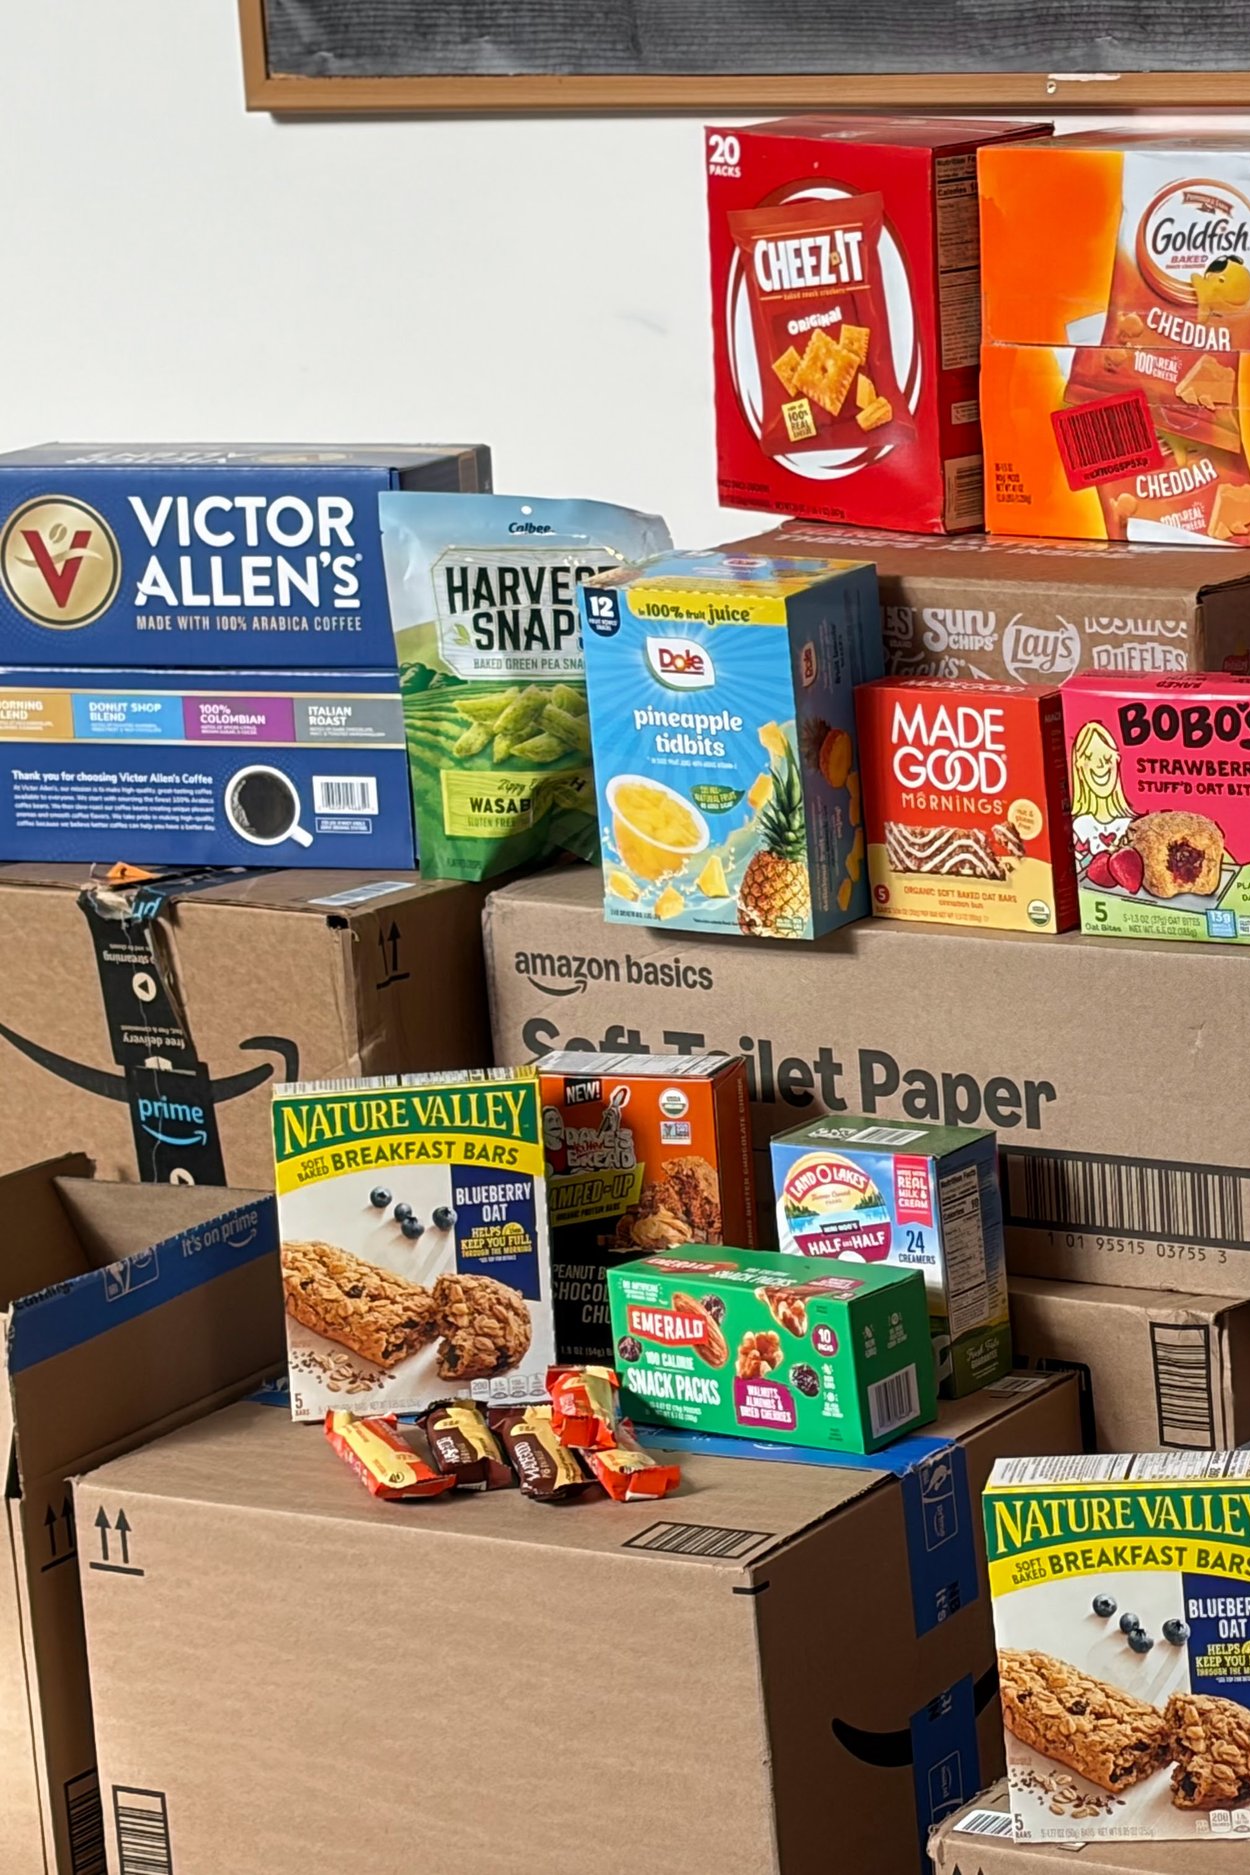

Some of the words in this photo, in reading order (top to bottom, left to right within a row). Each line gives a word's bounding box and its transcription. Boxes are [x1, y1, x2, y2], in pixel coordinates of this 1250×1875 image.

[709, 135, 741, 165] 20
[709, 165, 741, 178] PACKS
[1152, 216, 1250, 255] Goldfish
[788, 306, 842, 335] ORIGINAL
[1147, 307, 1231, 351] CHEDDAR
[1159, 357, 1178, 373] REAL
[1152, 367, 1178, 384] CHEESE
[1136, 458, 1218, 499] CHEDDAR
[127, 496, 356, 548] VICTOR
[508, 522, 552, 534] Calbee
[134, 551, 360, 609] ALLEN'S
[589, 596, 615, 617] 12
[645, 603, 684, 620] 100%
[707, 604, 747, 625] juice
[136, 616, 172, 631] MADE
[177, 616, 210, 631] WITH
[252, 616, 309, 632] ARABICA
[314, 617, 362, 632] COFFEE
[949, 635, 995, 650] CHIPS
[1011, 626, 1075, 673] Lay's
[474, 658, 502, 670] BAKED
[505, 658, 538, 670] GREEN
[541, 658, 560, 670] PEA
[658, 648, 704, 674] Dole
[200, 714, 265, 725] COLOMBIAN
[308, 706, 352, 717] ITALIAN
[309, 716, 346, 726] ROAST
[634, 708, 743, 735] pineapple
[892, 702, 1006, 752] MADE
[656, 733, 725, 757] tidbits
[11, 770, 41, 780] Thank
[43, 772, 59, 782] you
[61, 771, 74, 781] for
[77, 772, 117, 784] choosing
[119, 772, 147, 783] Victor
[182, 774, 213, 784] Coffee
[894, 746, 1007, 794] GOOD
[497, 778, 526, 795] Zippy
[1138, 780, 1193, 795] STUFF'D
[1196, 782, 1224, 795] OAT
[469, 797, 532, 814] WASAB
[904, 886, 936, 896] ORGANIC
[1095, 902, 1108, 922] 5
[515, 951, 620, 982] amazon
[625, 954, 714, 990] basics
[123, 1032, 163, 1048] delivery
[165, 1036, 185, 1049] free
[566, 1081, 600, 1104] NEW!
[858, 1048, 1057, 1130] Paper
[139, 1097, 203, 1126] prime
[281, 1098, 409, 1155] NATURE
[411, 1090, 527, 1137] VALLEY
[566, 1128, 633, 1149] DAVE'S
[301, 1156, 325, 1170] SOFT
[332, 1141, 455, 1171] BREAKFAST
[463, 1142, 519, 1165] BARS
[568, 1149, 636, 1169] BREAD
[298, 1165, 329, 1182] BAKED
[456, 1182, 532, 1205] BLUEBERRY
[789, 1171, 817, 1197] LAND
[898, 1189, 918, 1199] MILK
[481, 1204, 508, 1222] OAT
[898, 1198, 928, 1209] CREAM
[204, 1229, 220, 1247] on
[221, 1210, 258, 1240] prime
[471, 1226, 501, 1237] HELPS
[461, 1238, 486, 1249] KEEP
[807, 1237, 842, 1256] HALF
[906, 1230, 925, 1254] 24
[1066, 1235, 1084, 1249] 01
[1096, 1237, 1145, 1255] 95515
[1157, 1243, 1207, 1261] 03755
[1218, 1250, 1227, 1263] 3
[899, 1252, 936, 1265] CREAMERS
[631, 1311, 705, 1339] EMERALD
[818, 1328, 831, 1343] 10
[628, 1368, 675, 1399] SNACK
[676, 1375, 721, 1406] PACKS
[295, 1393, 304, 1409] 5
[993, 1496, 1134, 1554] NATURE
[1015, 1557, 1042, 1572] SOFT
[1049, 1545, 1187, 1575] BREAKFAST
[1012, 1567, 1047, 1585] BAKED
[1219, 1618, 1248, 1639] OAT
[1207, 1644, 1241, 1655] HELPS
[1224, 1655, 1247, 1666] YOU
[1015, 1814, 1024, 1830] 5
